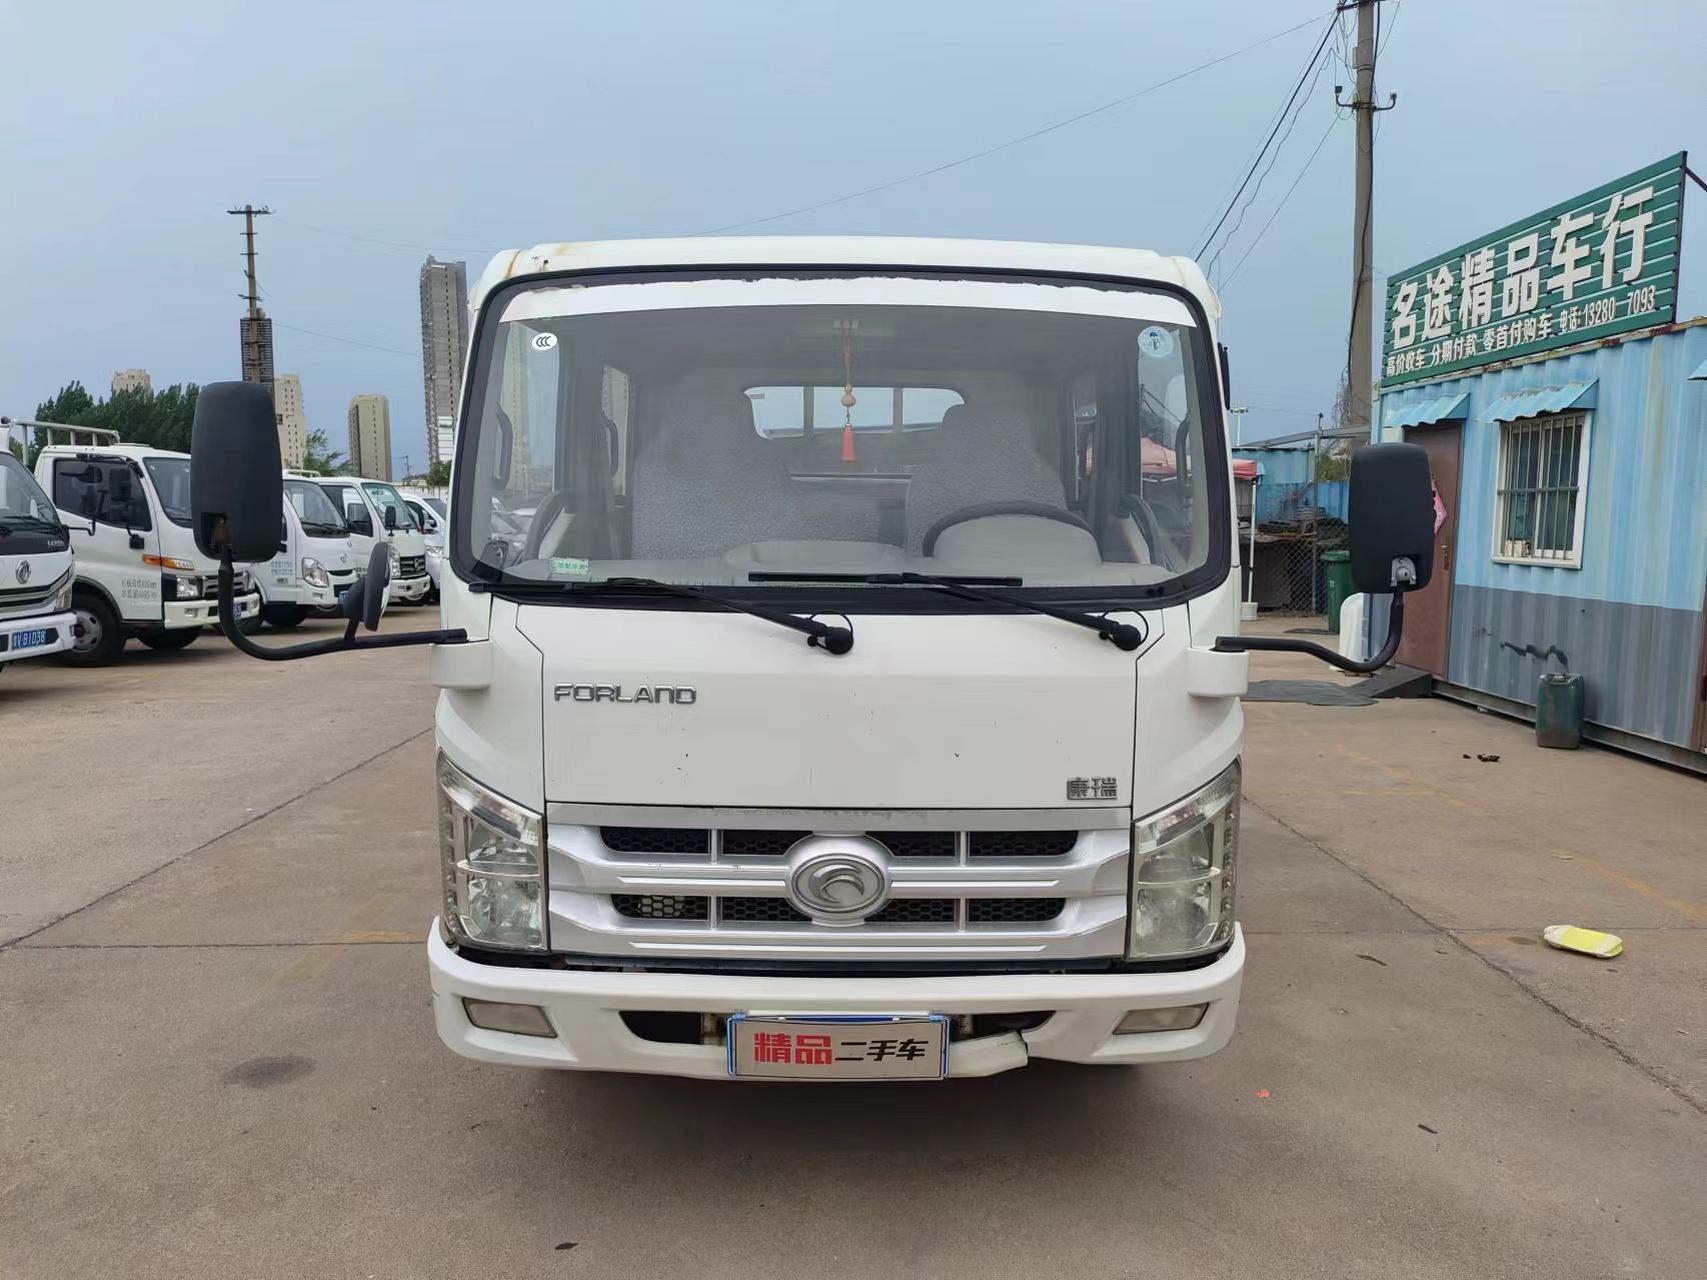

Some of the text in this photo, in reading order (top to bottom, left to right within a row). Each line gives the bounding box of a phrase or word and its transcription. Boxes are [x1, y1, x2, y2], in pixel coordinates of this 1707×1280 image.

[1392, 186, 1656, 350] 名途精品车行
[1386, 348, 1427, 377] 高价收车
[1431, 333, 1478, 365] 分期付款
[1482, 313, 1554, 351] 零首付购车
[554, 682, 697, 705] FORLAND
